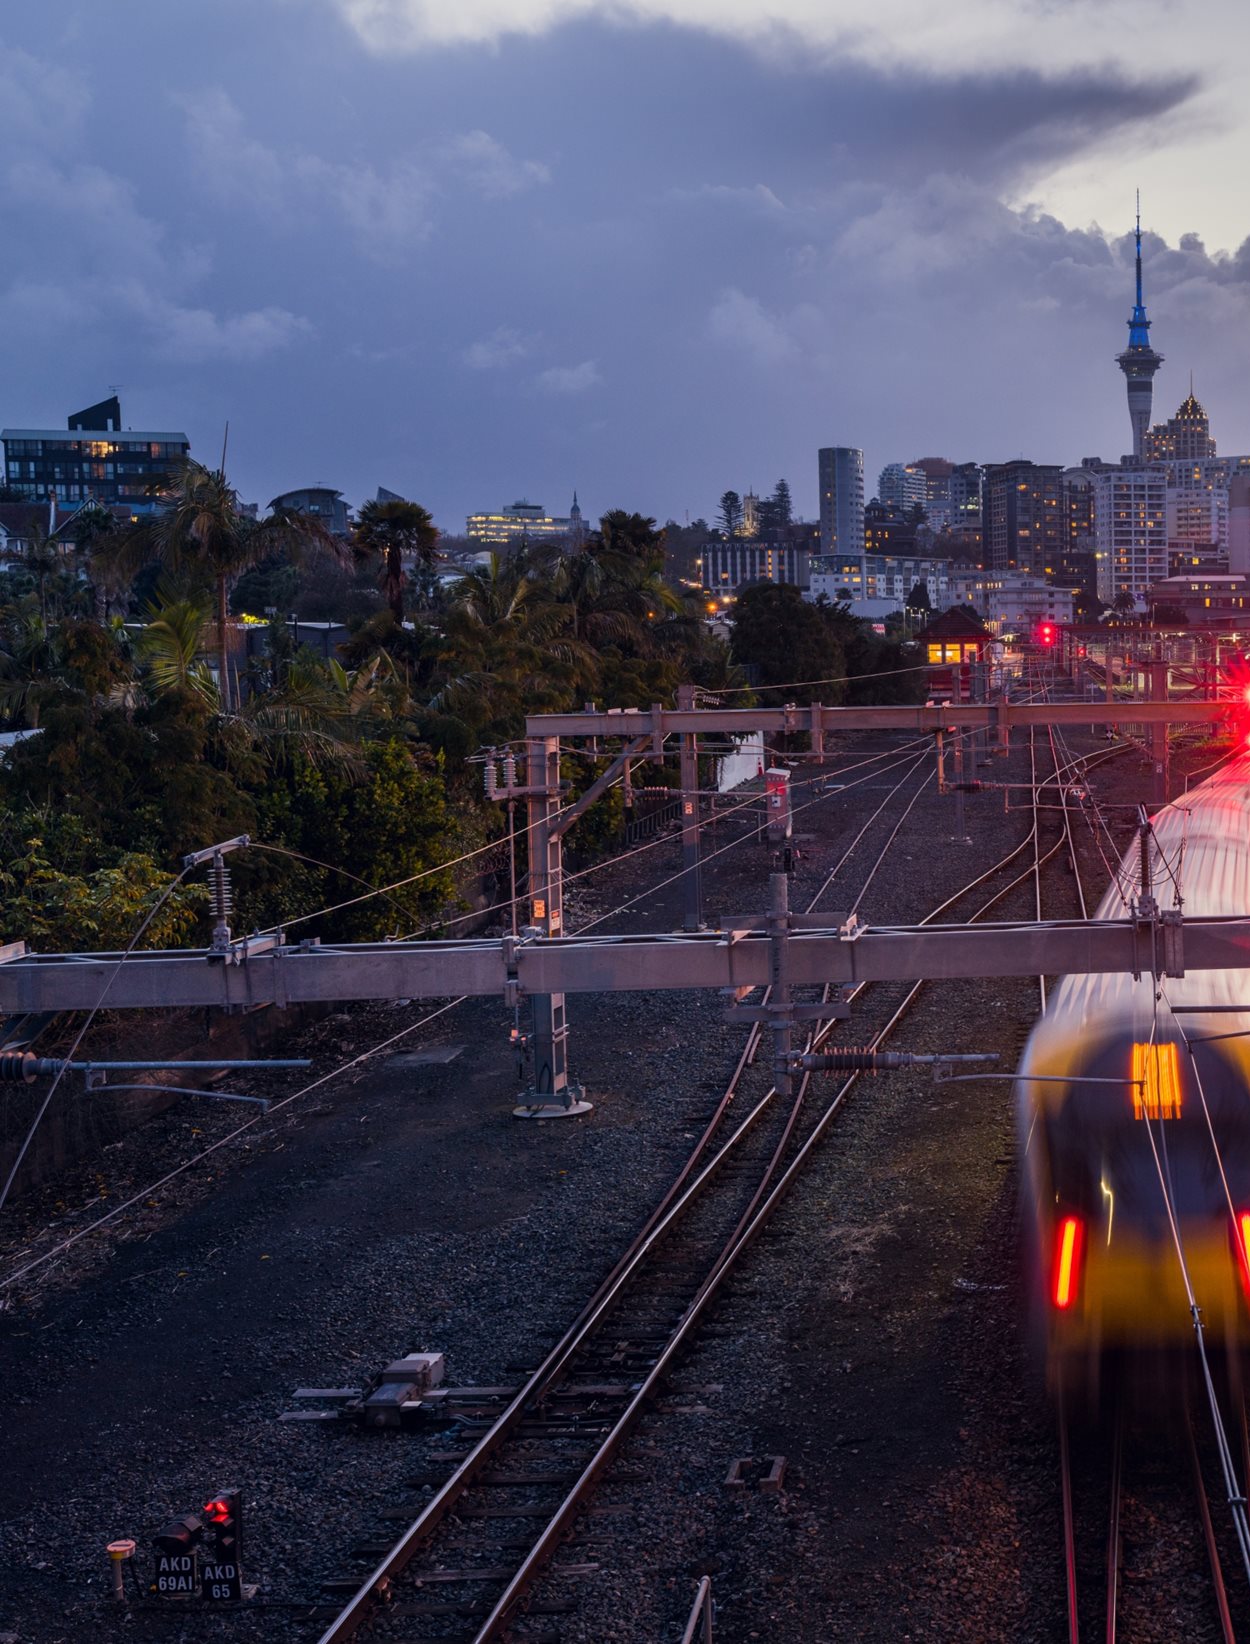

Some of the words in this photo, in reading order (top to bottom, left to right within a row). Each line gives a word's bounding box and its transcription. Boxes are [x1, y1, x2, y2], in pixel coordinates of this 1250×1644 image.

[160, 1557, 191, 1571] AKD
[204, 1565, 235, 1580] AKD
[212, 1584, 231, 1598] 65
